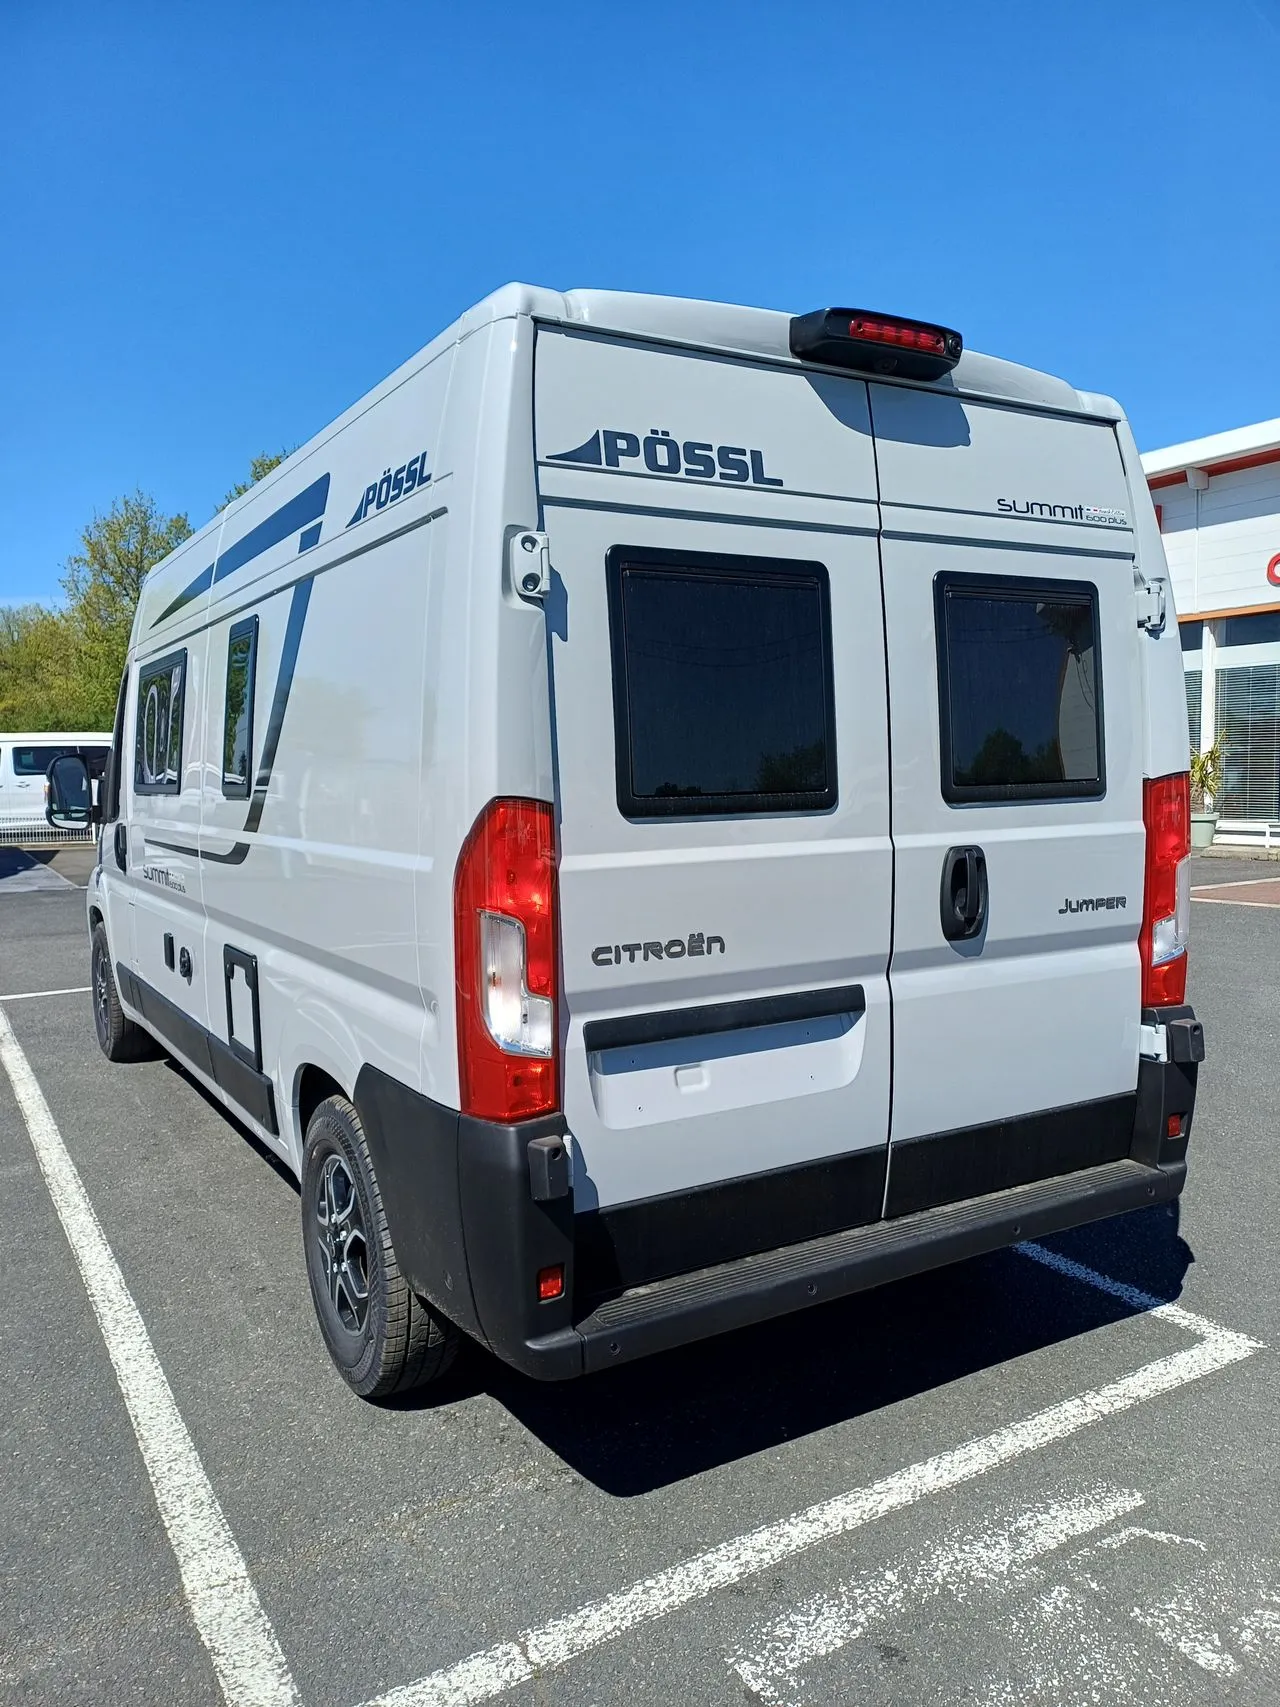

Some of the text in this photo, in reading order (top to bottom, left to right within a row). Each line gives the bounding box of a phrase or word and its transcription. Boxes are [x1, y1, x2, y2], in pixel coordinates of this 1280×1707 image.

[602, 429, 784, 487] PÖSSL
[363, 450, 432, 518] PÖSSL
[1086, 515, 1128, 526] 600 plus
[1058, 896, 1127, 915] JUMPER
